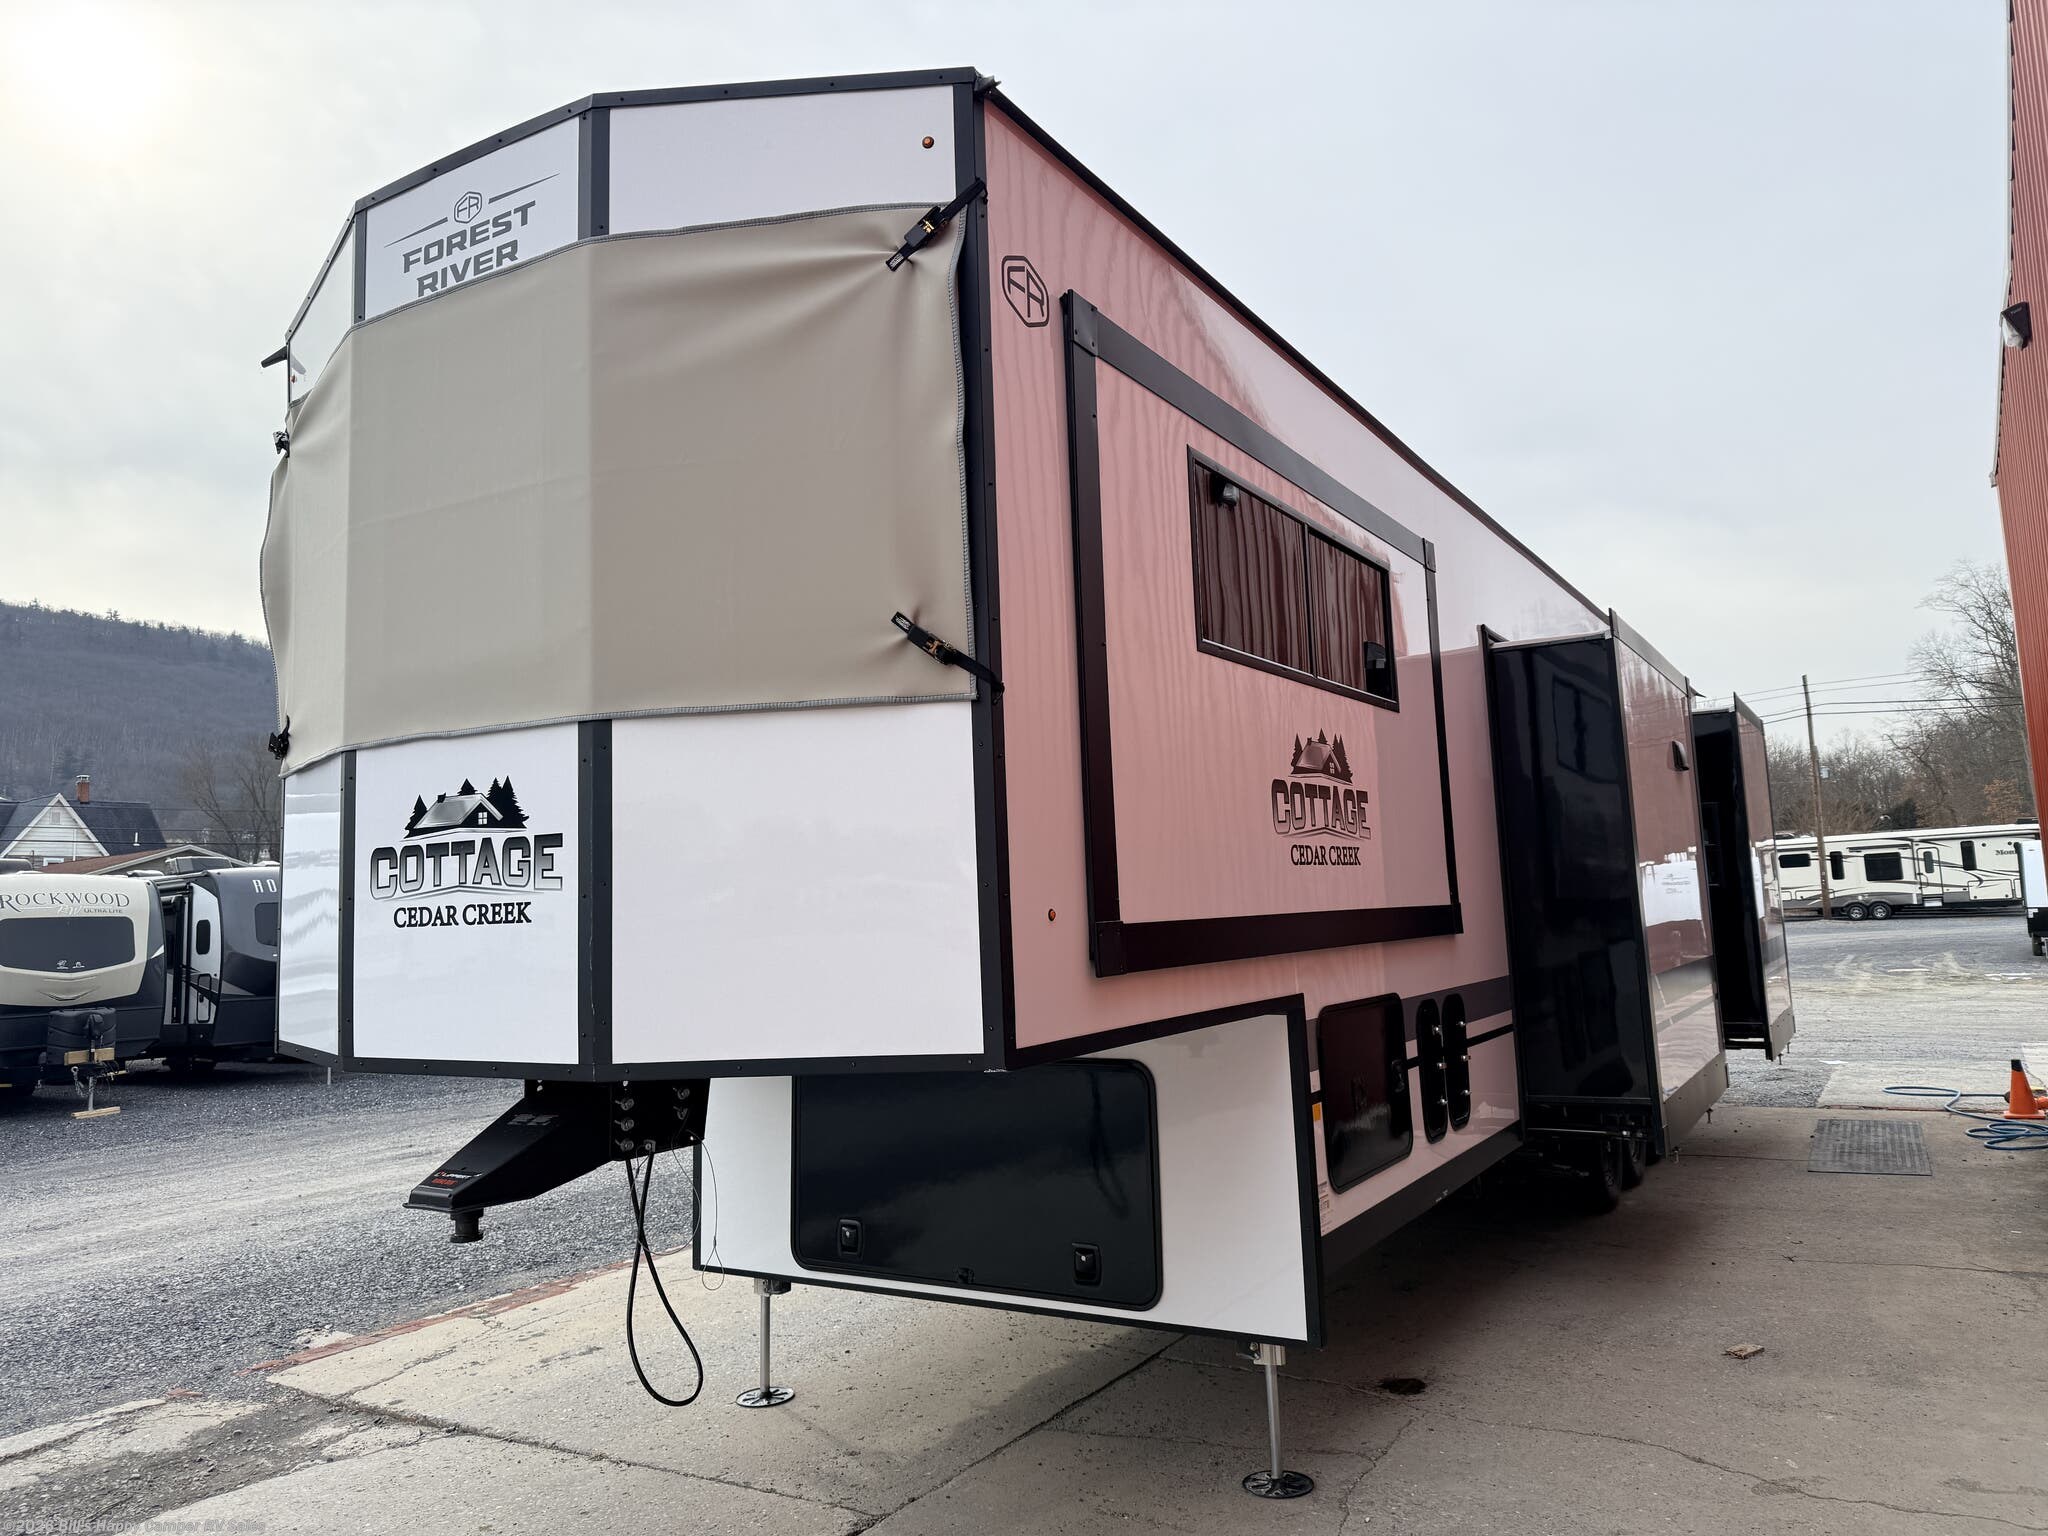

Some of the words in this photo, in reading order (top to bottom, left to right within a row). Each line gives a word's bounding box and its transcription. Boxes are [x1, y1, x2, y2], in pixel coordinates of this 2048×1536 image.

[403, 200, 536, 274] FOREST
[417, 239, 519, 298] RIVER
[1271, 779, 1372, 840] COTTAGE
[369, 832, 564, 900] COTTAGE
[1290, 844, 1329, 867] CEDAR
[1329, 845, 1362, 867] CREEK
[0, 892, 130, 913] ROCKWOOD
[393, 905, 459, 929] CEDAR
[462, 901, 532, 926] CREEK
